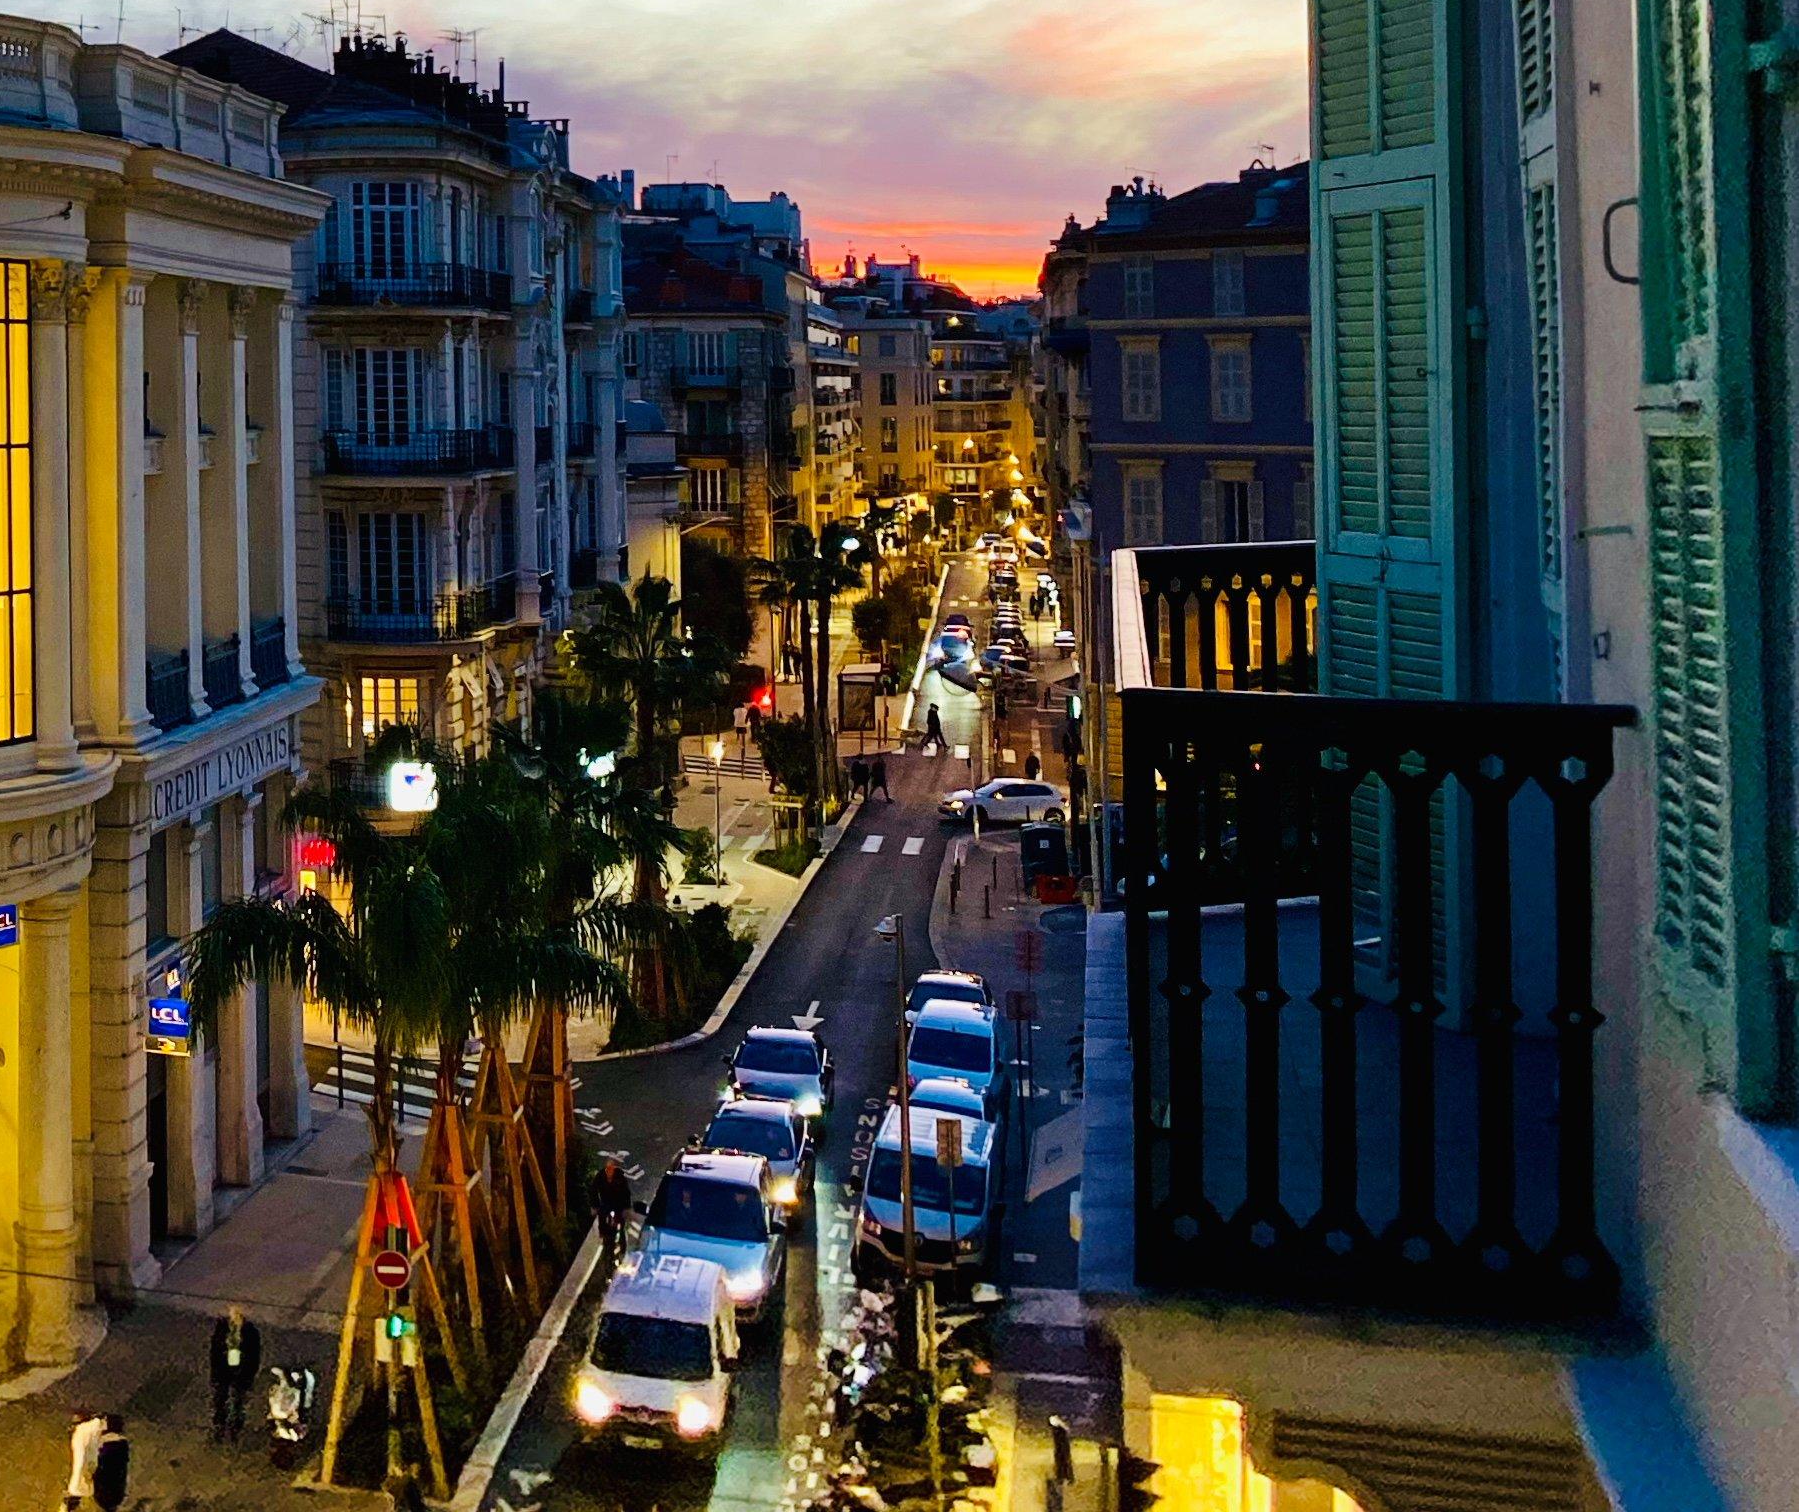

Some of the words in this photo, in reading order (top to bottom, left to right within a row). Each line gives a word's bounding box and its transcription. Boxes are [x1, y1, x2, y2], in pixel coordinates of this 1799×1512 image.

[154, 761, 210, 821] CREDIT
[217, 727, 287, 791] LYONNAIS
[151, 1007, 184, 1023] LCL
